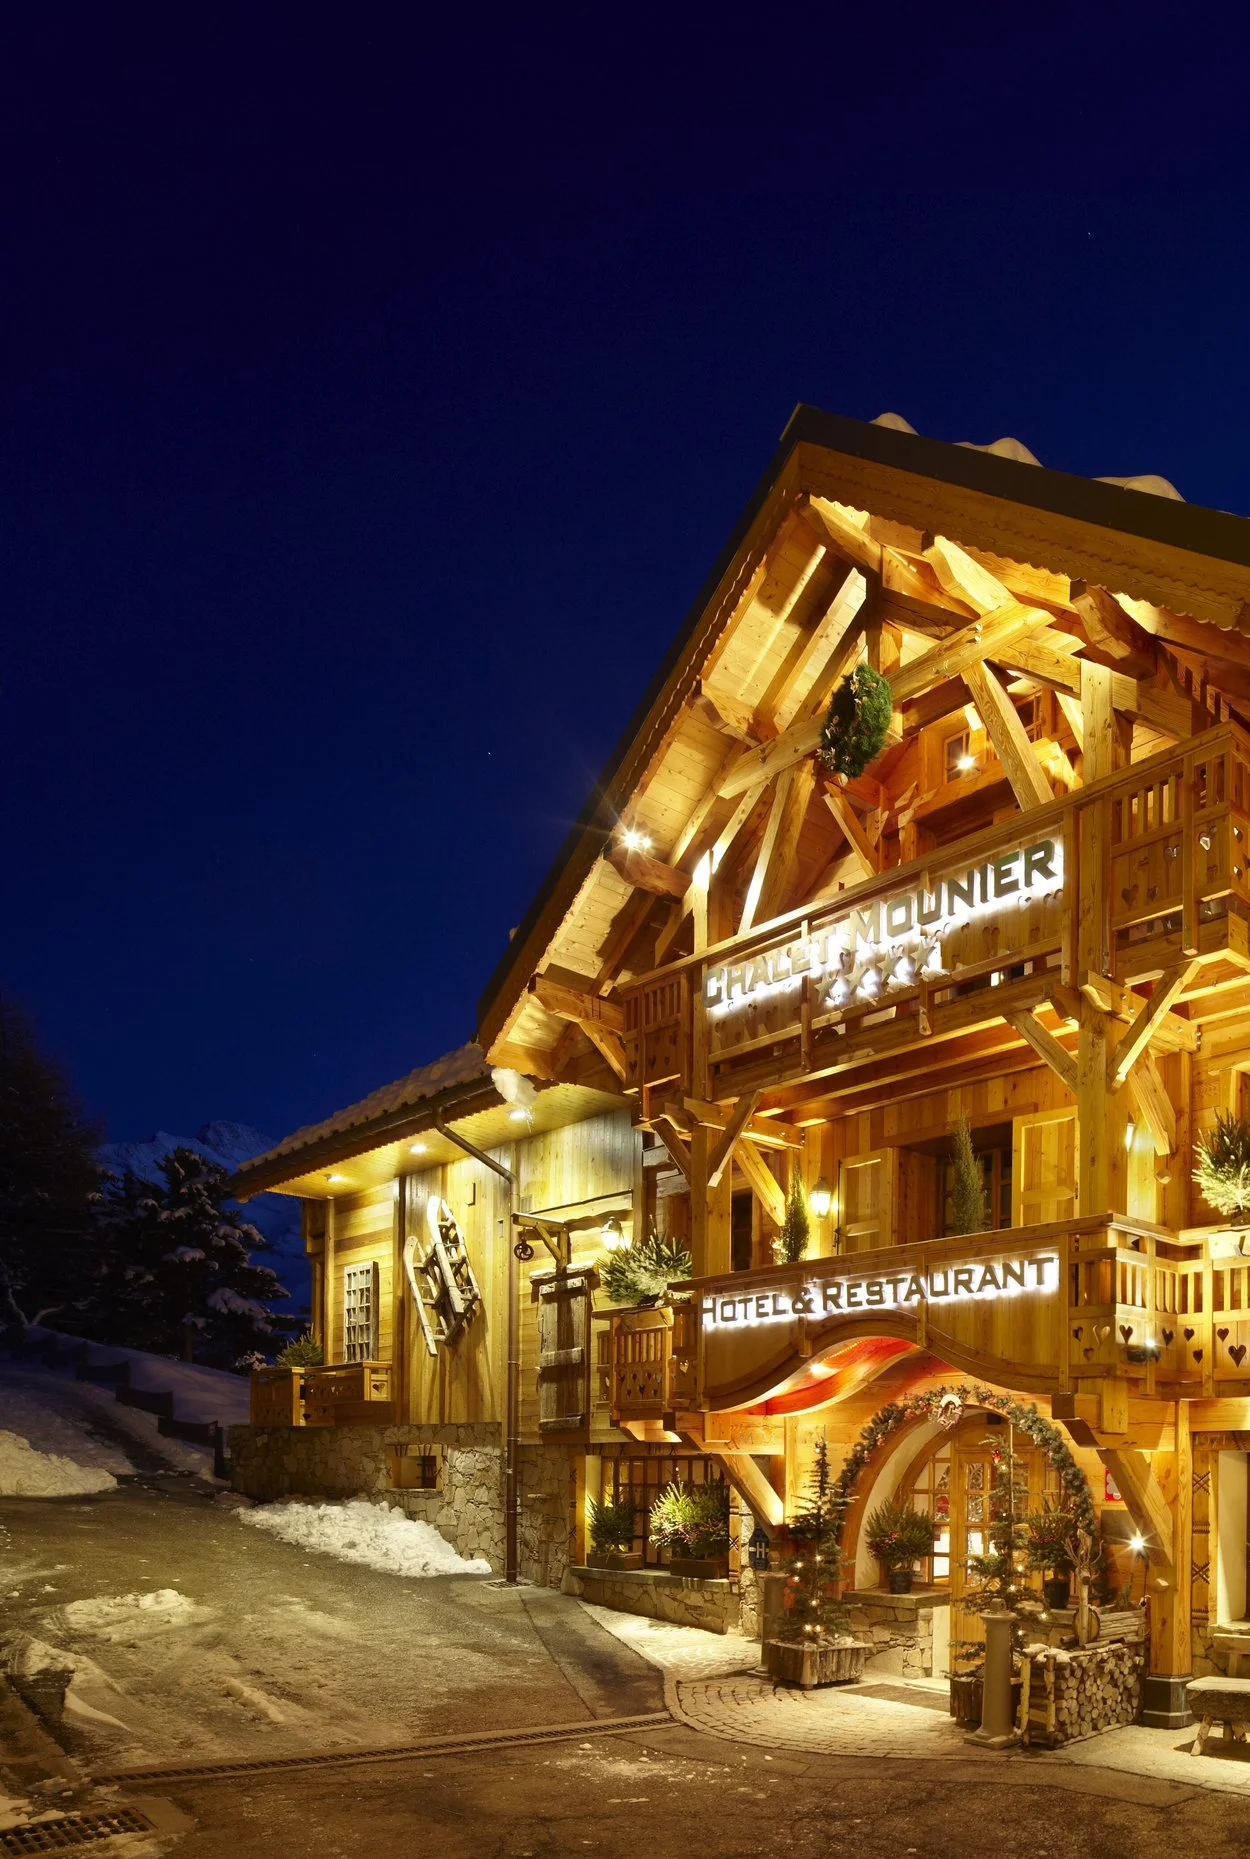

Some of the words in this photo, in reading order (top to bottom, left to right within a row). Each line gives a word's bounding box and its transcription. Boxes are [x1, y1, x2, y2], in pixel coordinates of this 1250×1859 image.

[702, 926, 836, 1008] CHALET
[849, 839, 1058, 945] MOUNIER
[700, 1293, 788, 1324] HOTEL
[822, 1256, 1055, 1311] RESTAURANT
[1195, 1434, 1226, 1449] 1971
